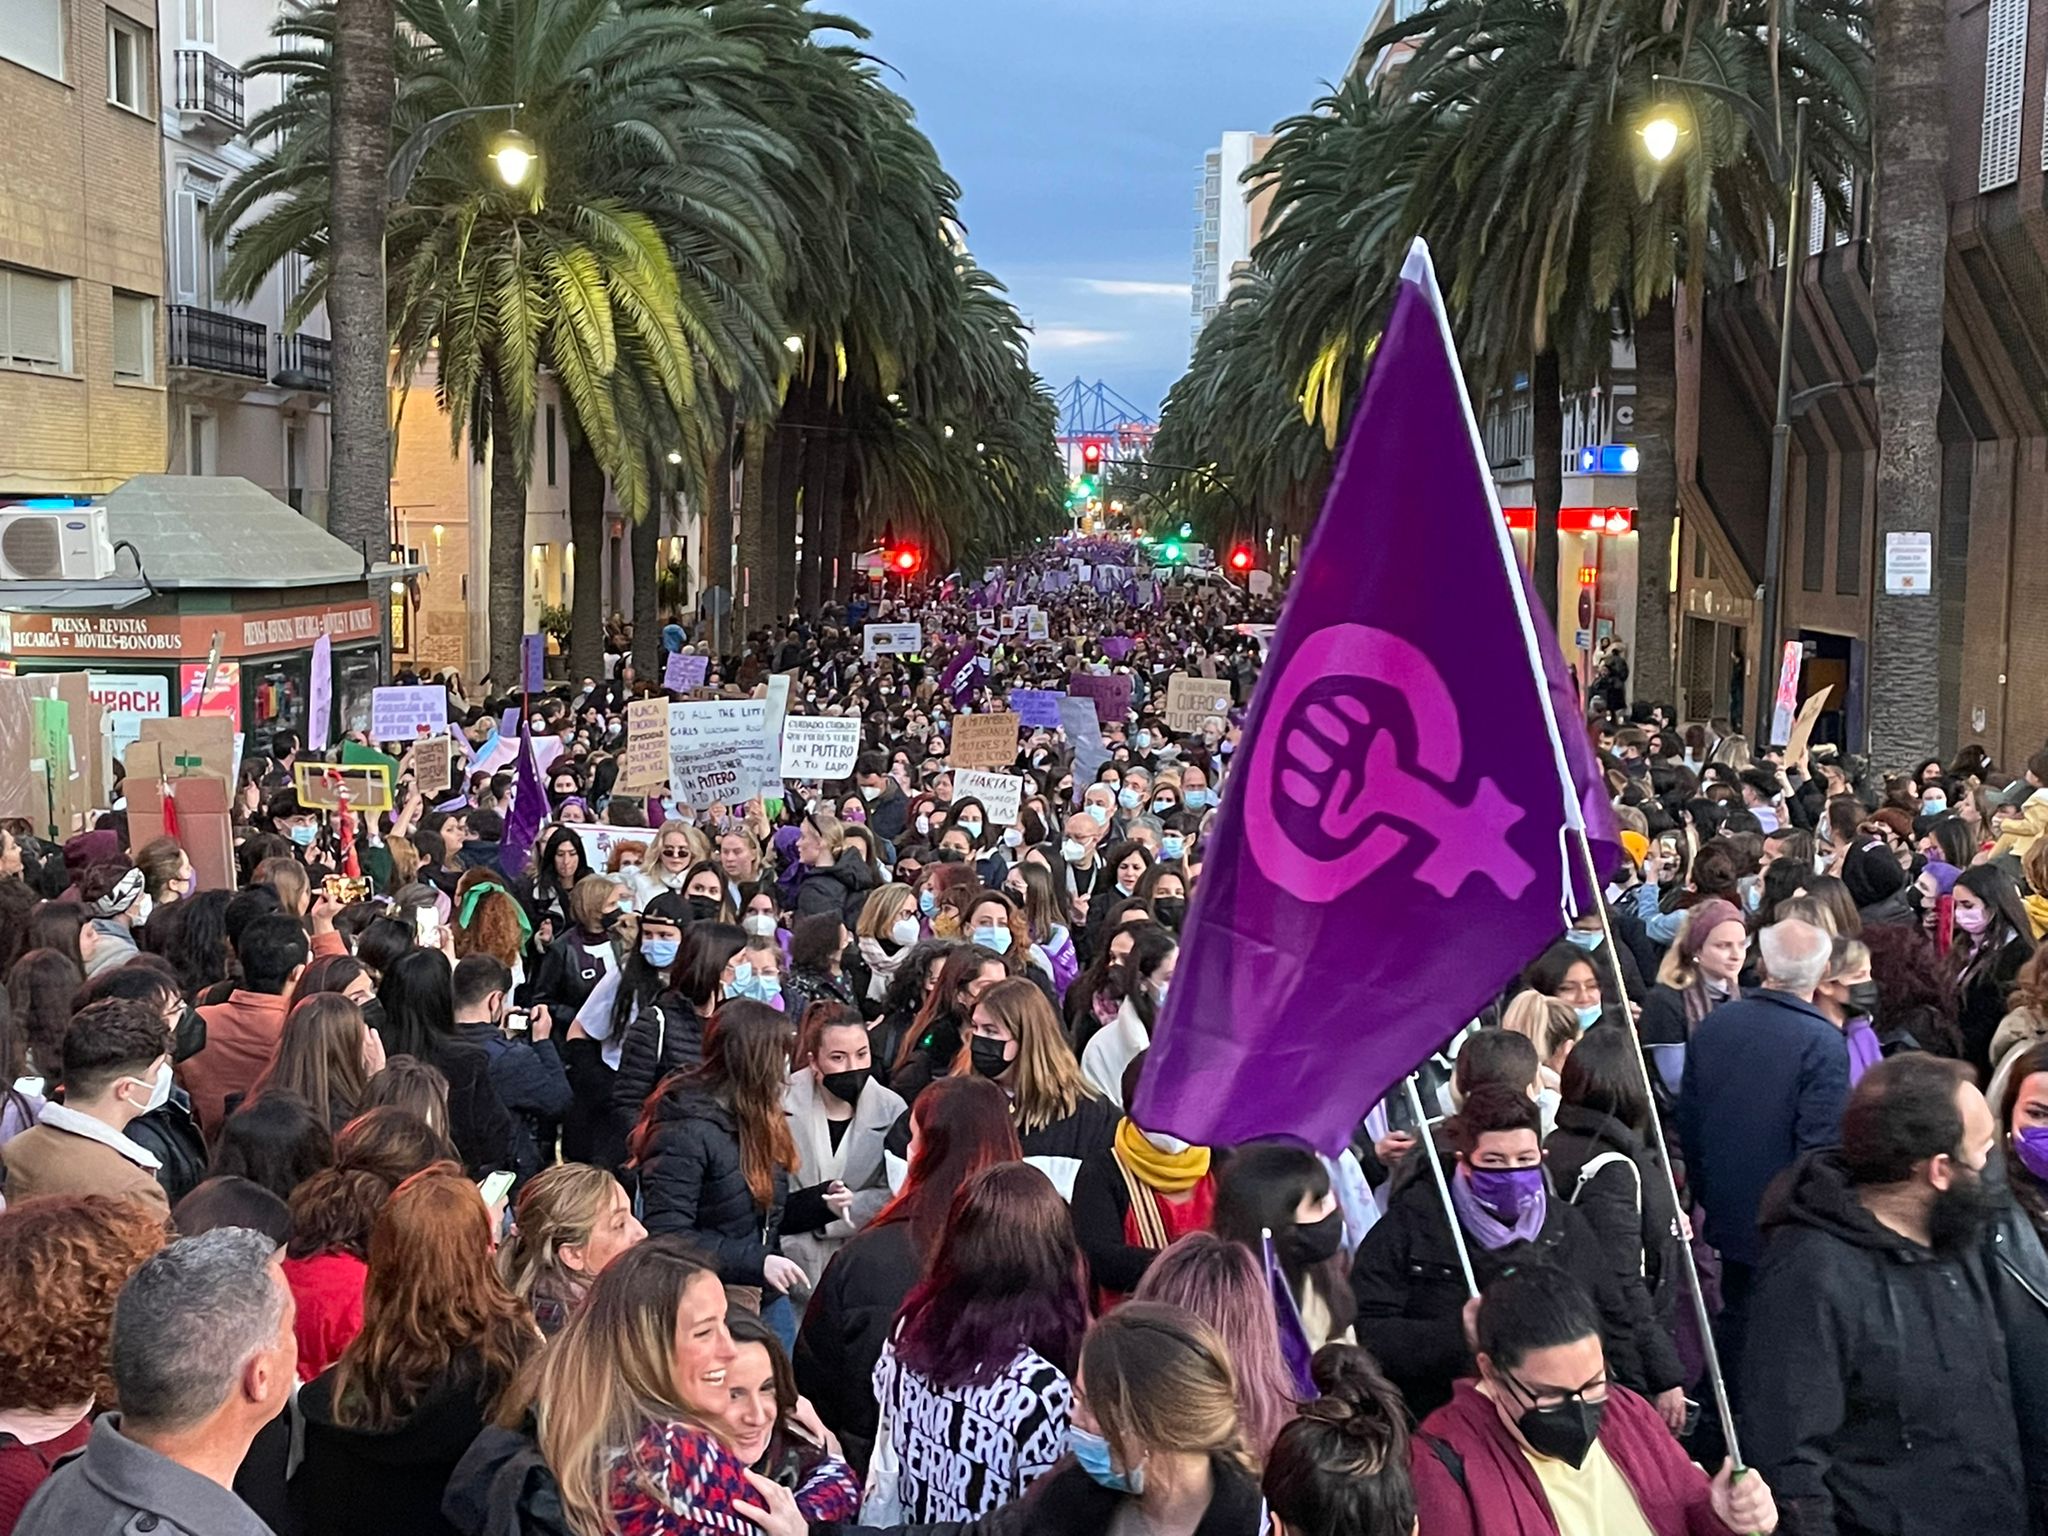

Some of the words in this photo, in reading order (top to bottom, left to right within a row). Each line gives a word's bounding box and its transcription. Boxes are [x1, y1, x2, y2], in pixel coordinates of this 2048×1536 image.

[52, 617, 91, 633] PRENSA
[99, 618, 147, 634] REVISTAS
[13, 632, 60, 648] RECARGA
[630, 705, 659, 717] NUNCA
[718, 709, 734, 718] THE
[670, 726, 698, 736] GIRLS
[792, 744, 807, 753] UN
[811, 743, 854, 758] PUTERO
[825, 761, 849, 772] LADO
[697, 770, 737, 790] PUTERO
[712, 787, 740, 802] LADO
